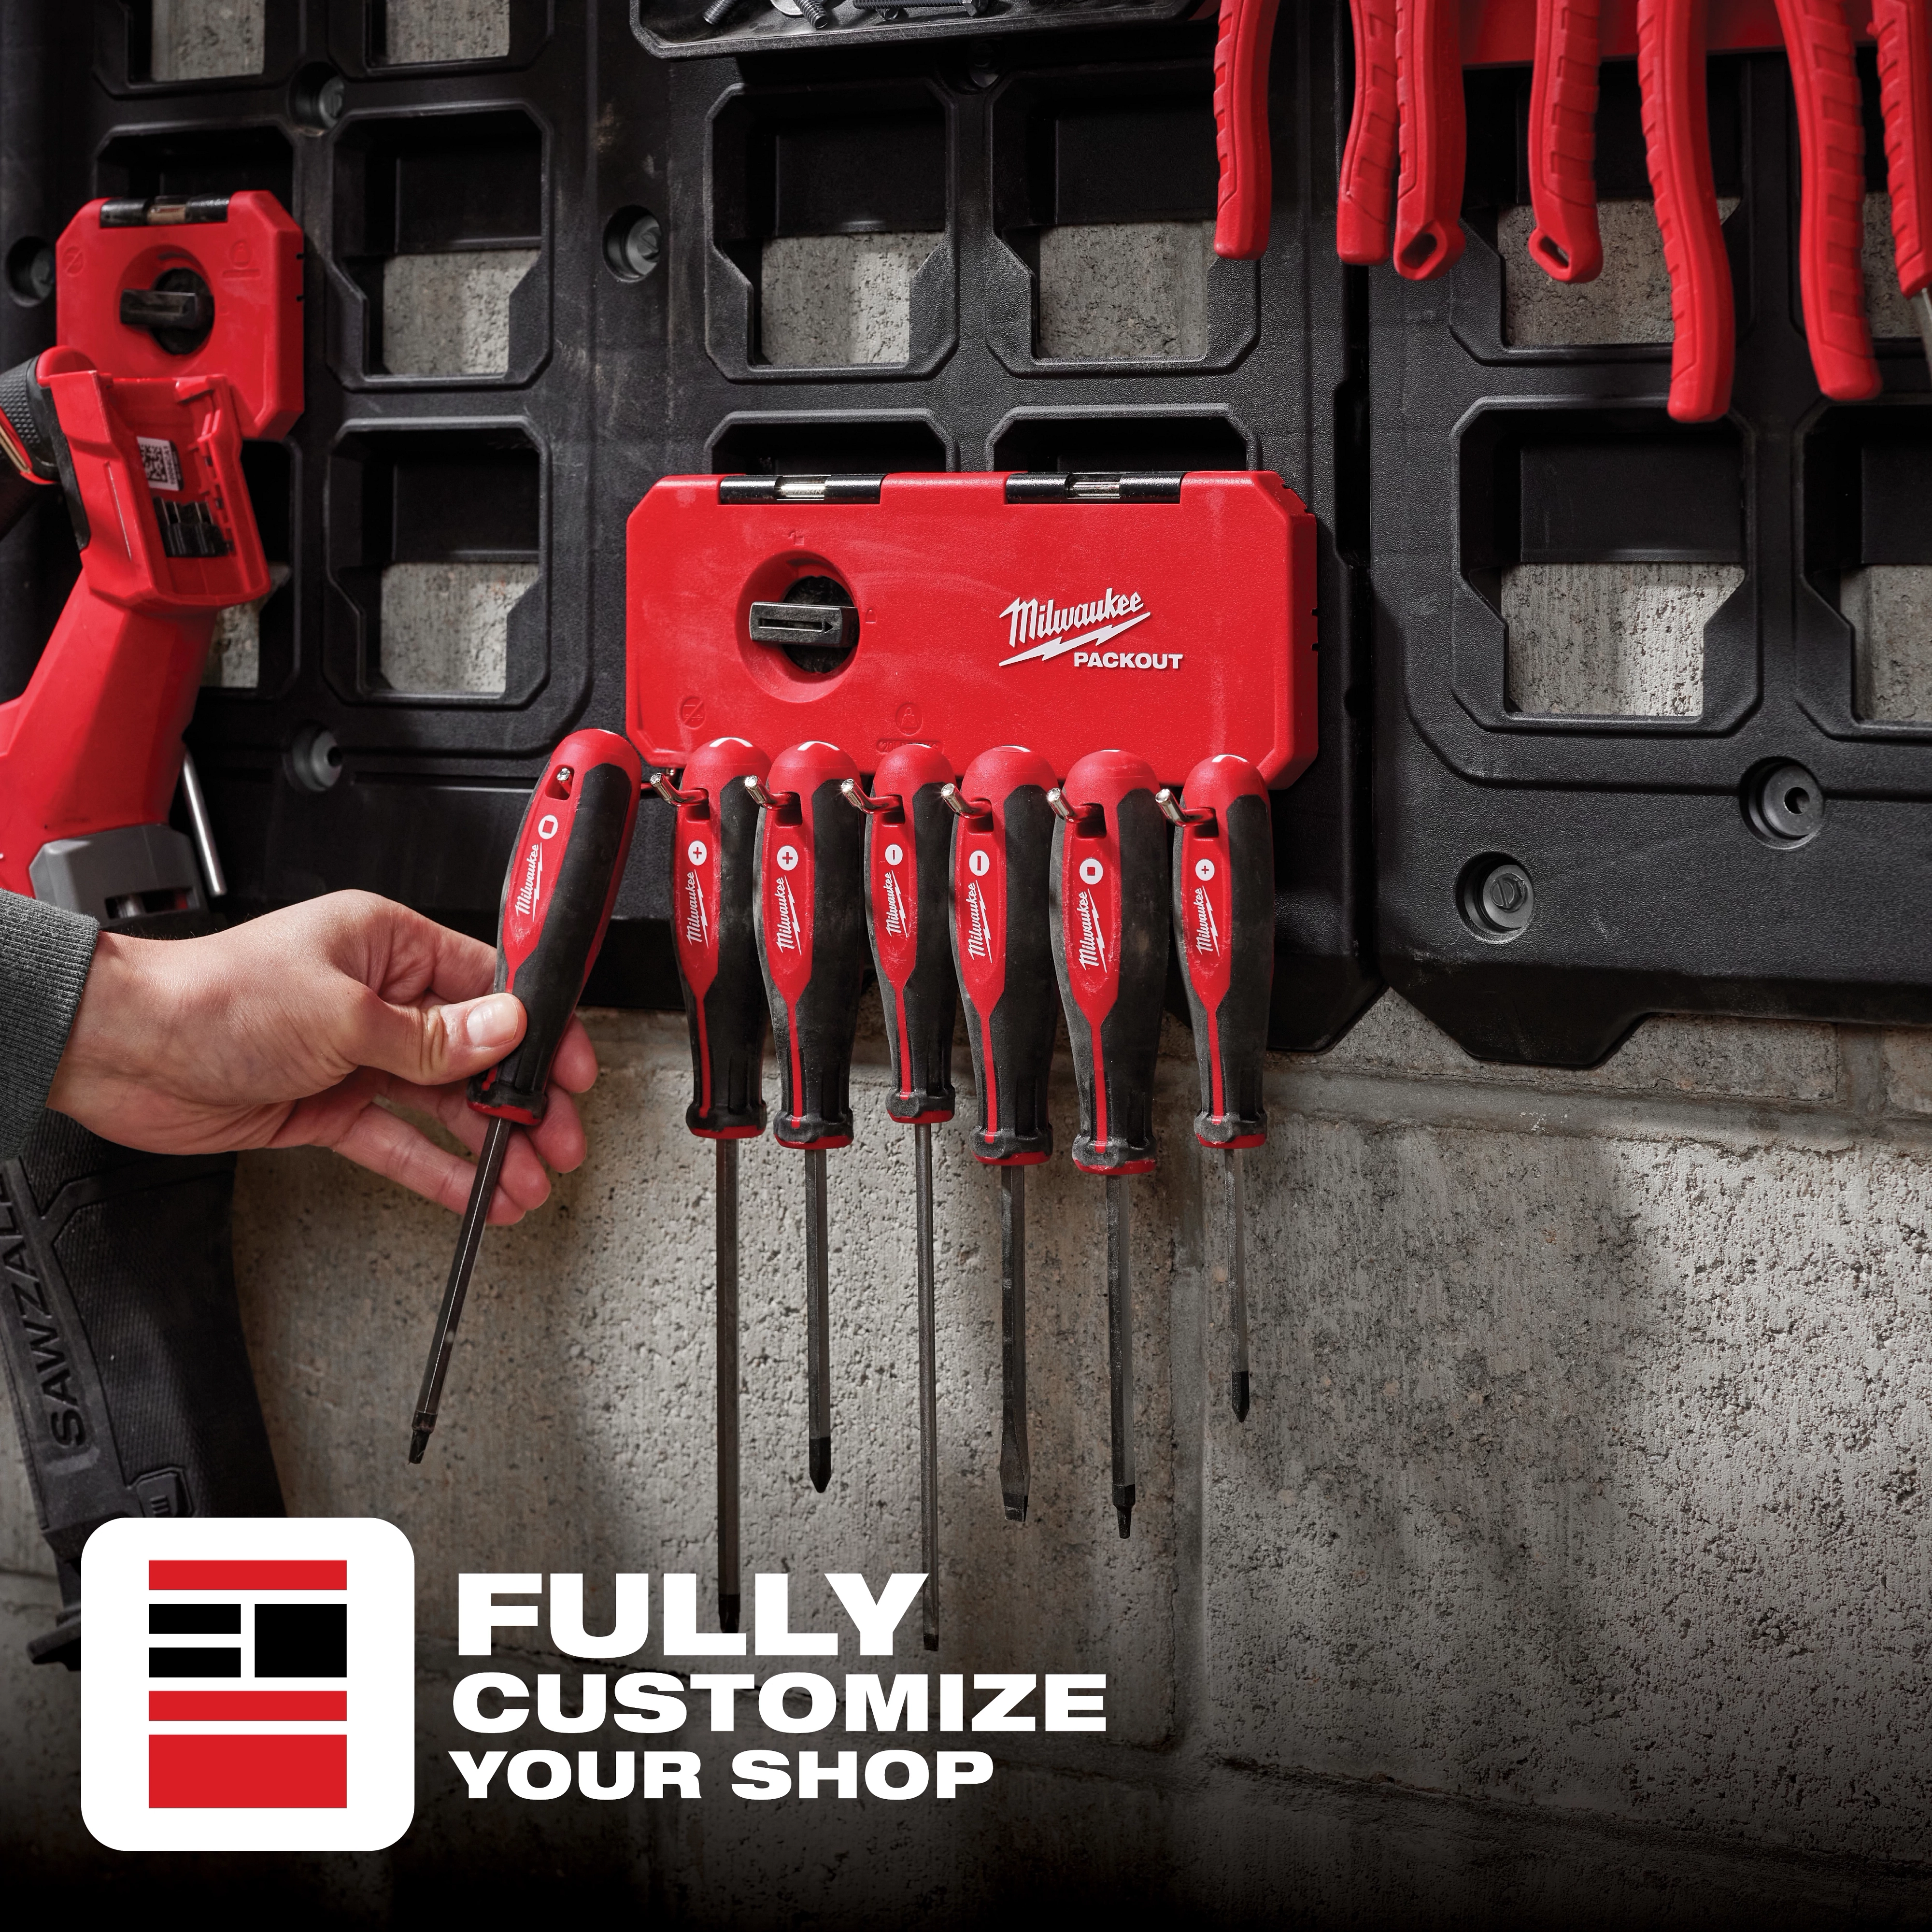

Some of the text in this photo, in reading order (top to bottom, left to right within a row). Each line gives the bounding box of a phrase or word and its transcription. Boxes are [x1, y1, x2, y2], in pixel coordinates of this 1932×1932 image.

[999, 587, 1144, 648] Milwaukee
[1074, 652, 1183, 669] PACKOUT
[514, 844, 539, 917] Milwaukee
[685, 871, 703, 946] Milwaukee
[774, 877, 795, 953] Milwaukee
[883, 872, 902, 937] Milwaukee
[966, 882, 986, 960] Milwaukee
[1077, 891, 1099, 970] Milwaukee
[1193, 888, 1214, 955] Milwaukee
